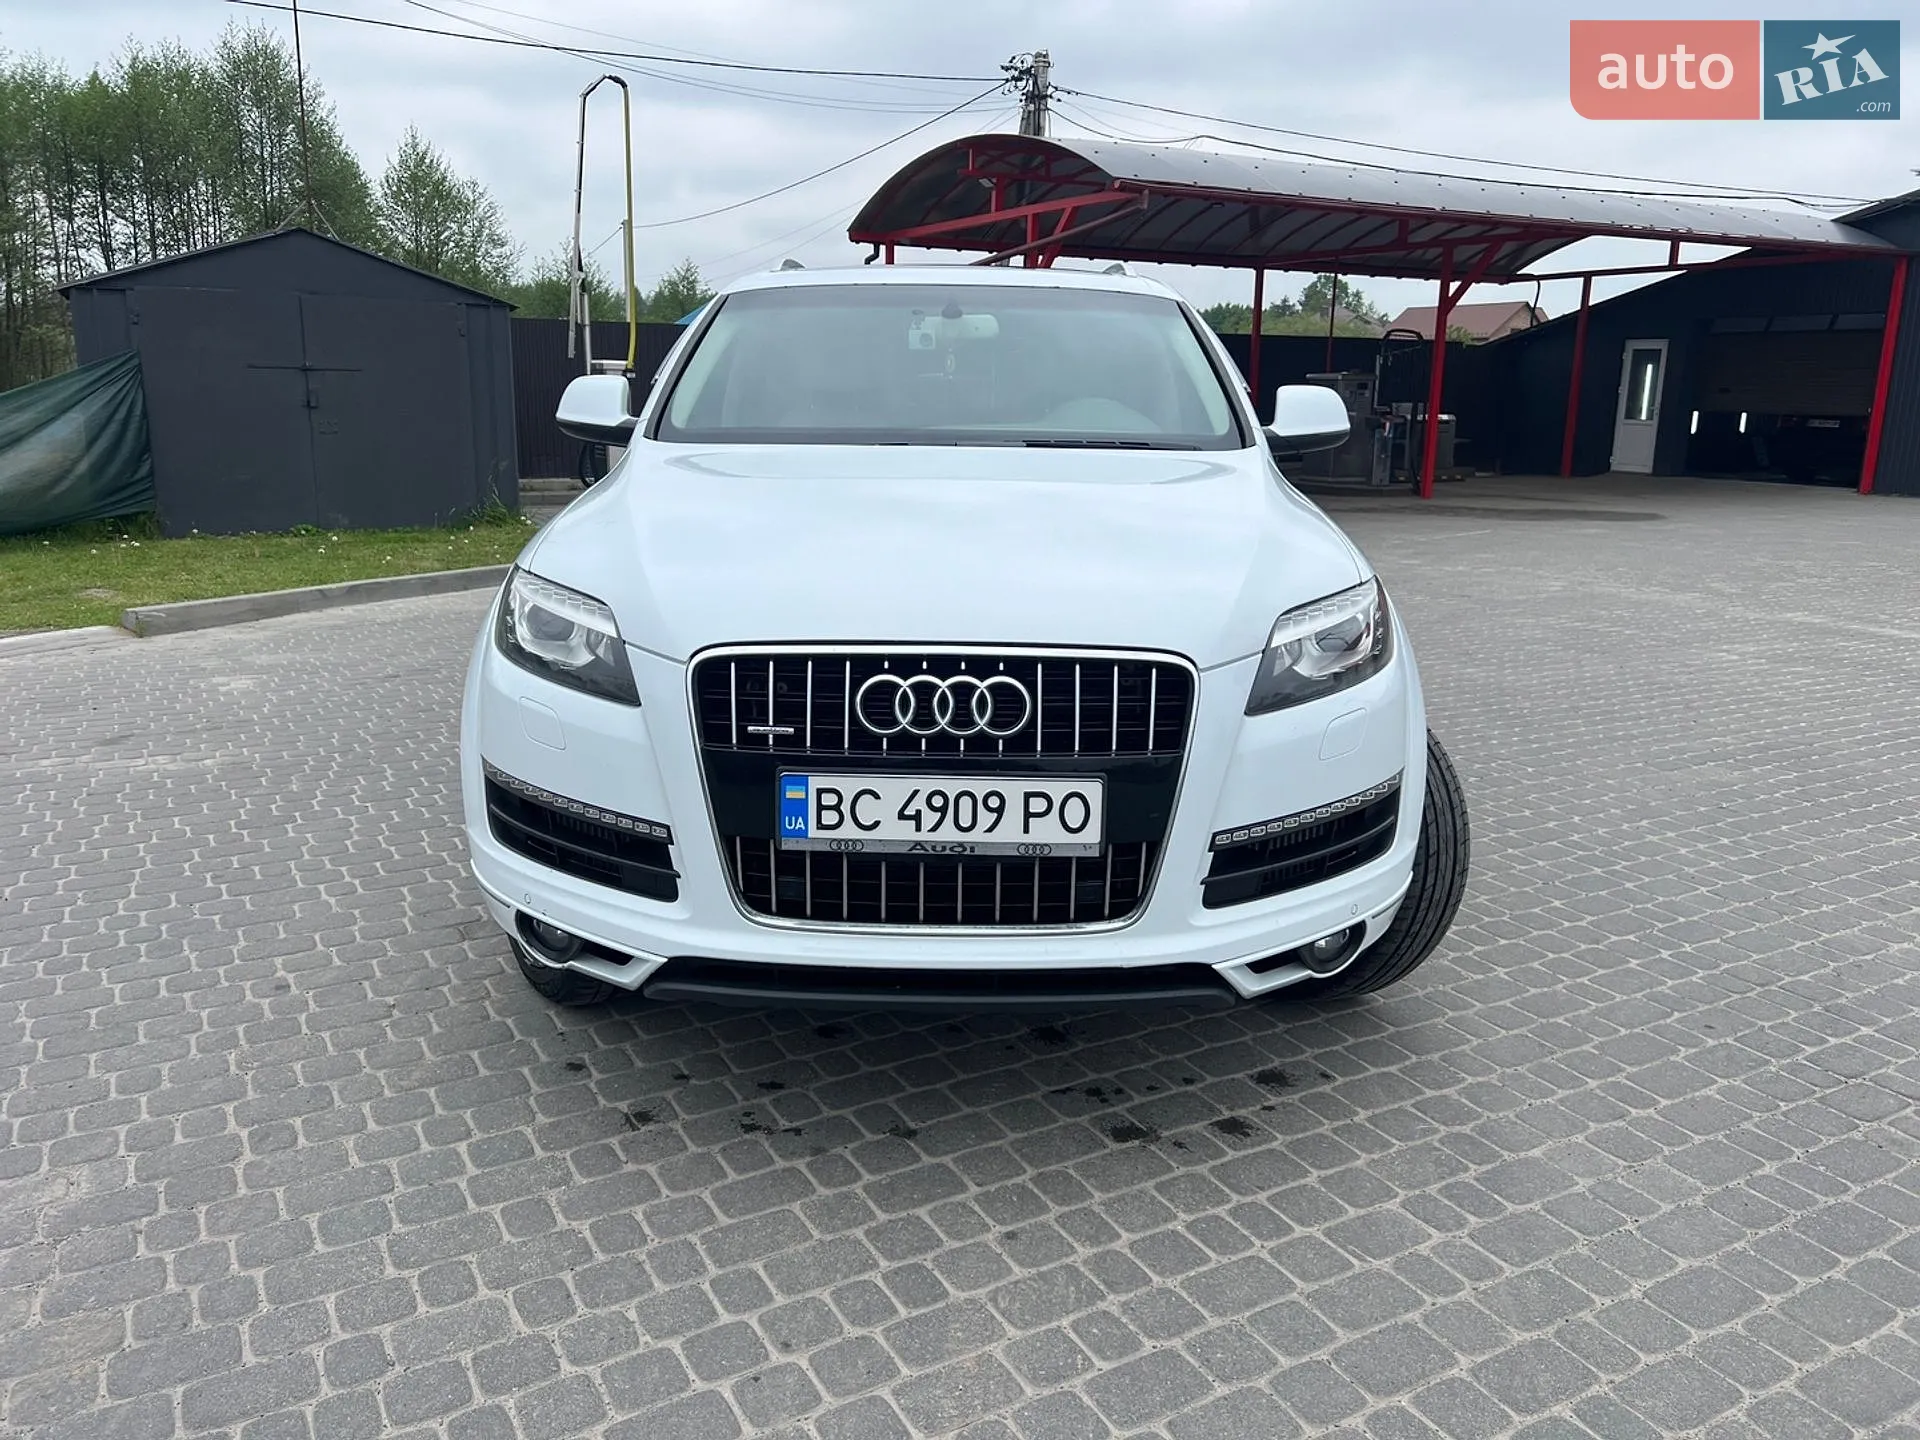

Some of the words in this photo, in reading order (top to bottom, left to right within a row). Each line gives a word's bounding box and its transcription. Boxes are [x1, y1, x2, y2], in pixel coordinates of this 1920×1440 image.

[815, 787, 881, 832] BC
[897, 788, 1007, 834] 4909
[1022, 790, 1091, 835] PO
[785, 816, 805, 830] UA
[907, 841, 976, 854] Audi
